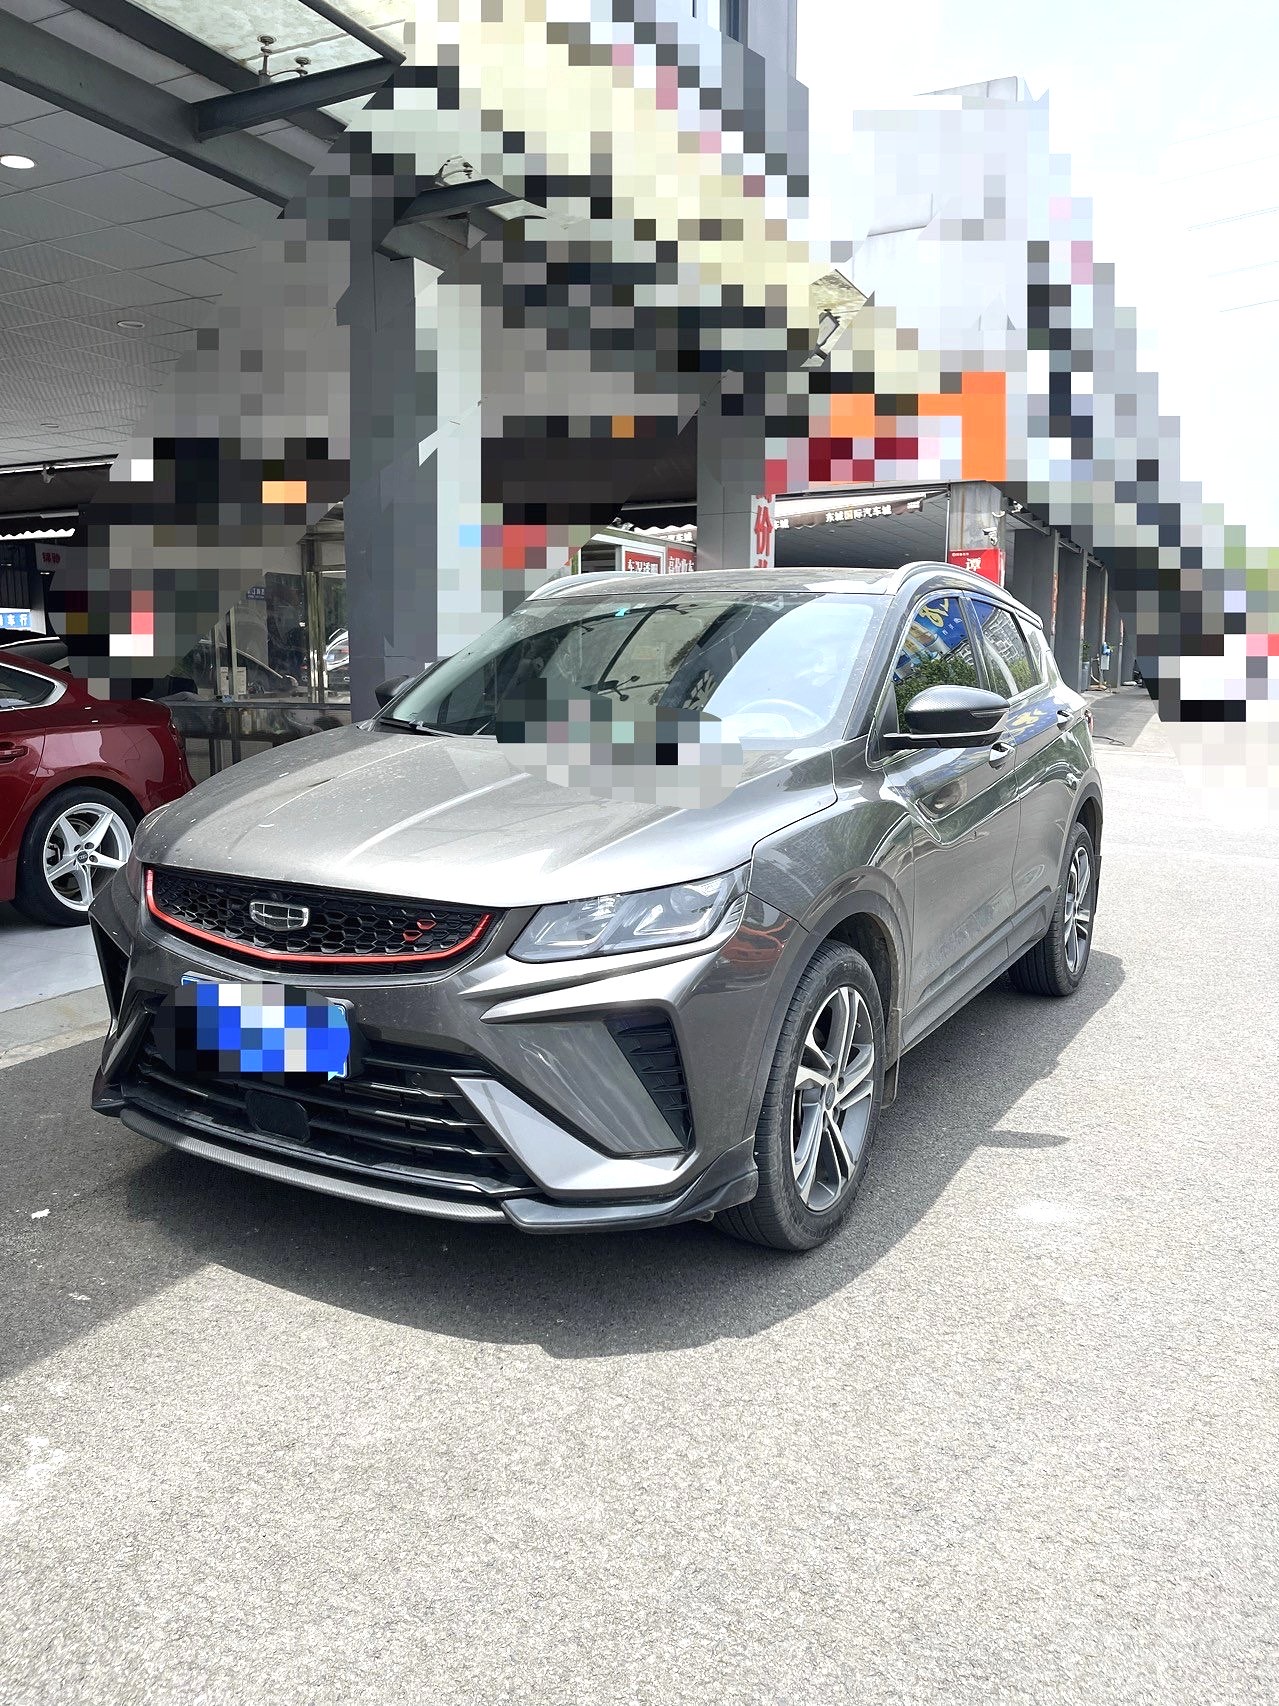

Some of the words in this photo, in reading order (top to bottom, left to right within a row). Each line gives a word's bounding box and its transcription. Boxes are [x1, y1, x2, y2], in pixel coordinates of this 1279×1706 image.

[825, 504, 892, 523] 东城国际汽车城
